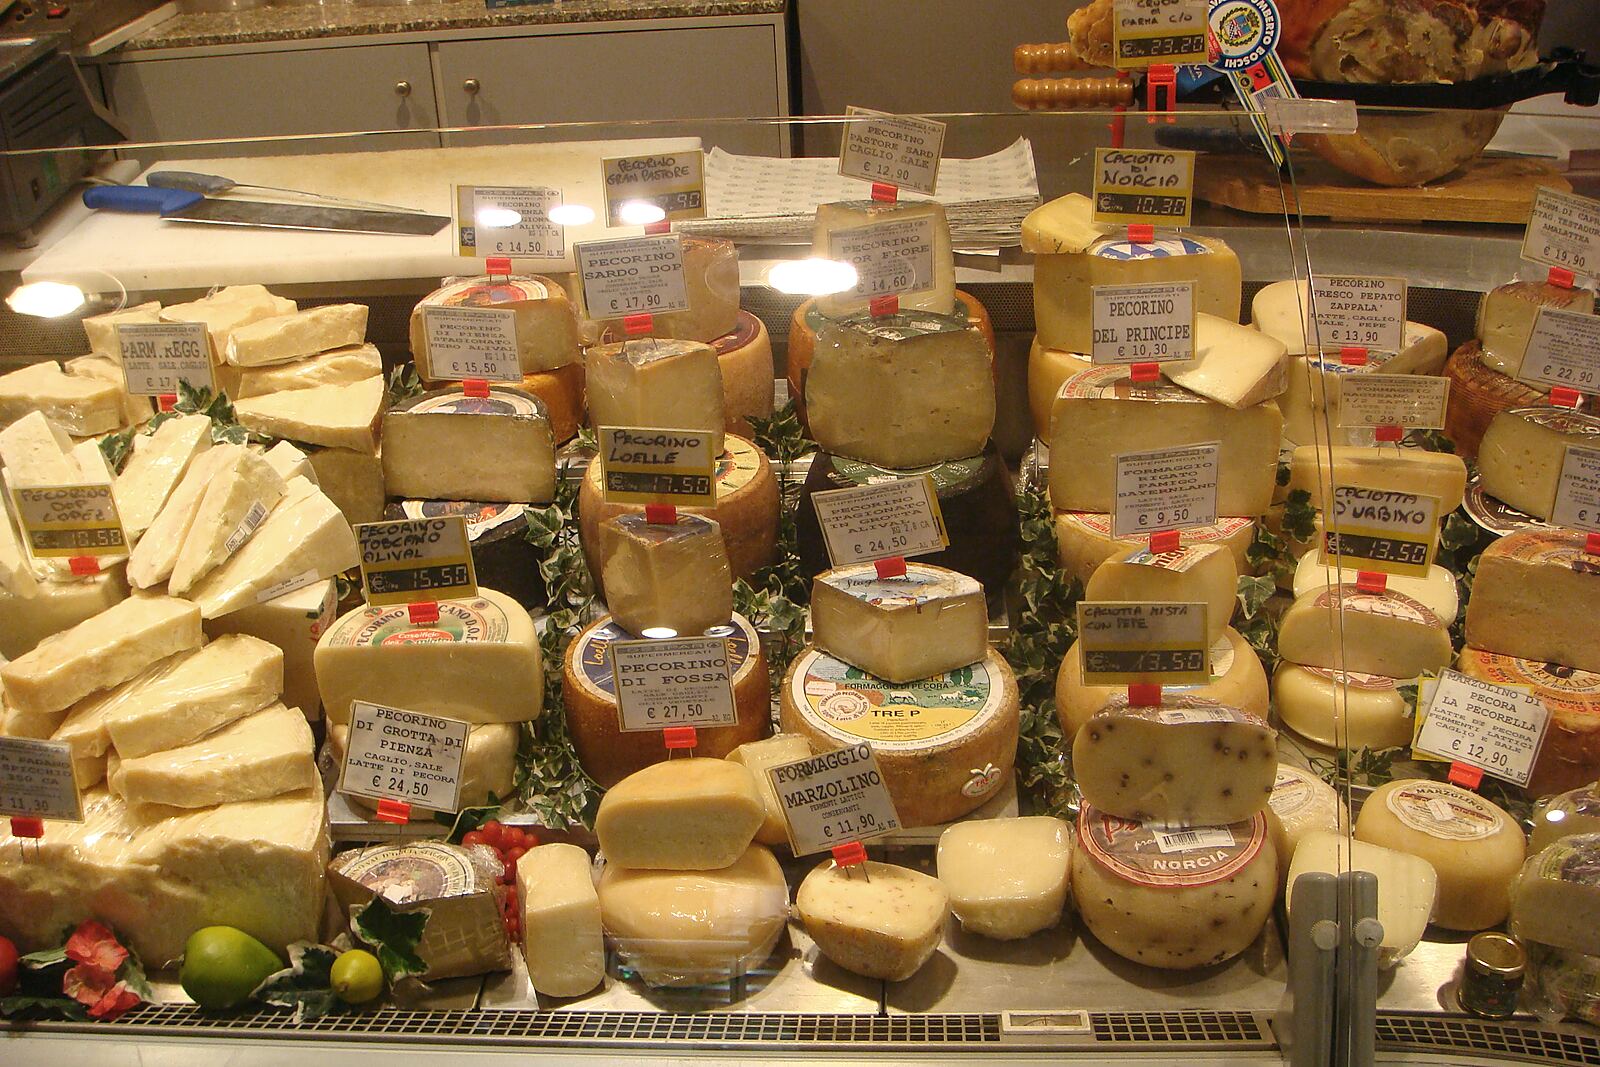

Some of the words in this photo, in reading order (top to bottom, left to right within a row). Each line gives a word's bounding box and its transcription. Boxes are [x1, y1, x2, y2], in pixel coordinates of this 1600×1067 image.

[1122, 17, 1158, 26] PARMA
[1151, 36, 1204, 55] 23.20
[1224, 46, 1265, 68] BOSCHI
[868, 126, 924, 144] PECORINO
[1104, 150, 1175, 164] CACIOTTA
[642, 166, 689, 182] PASTORE
[877, 164, 909, 180] 12,90
[1103, 170, 1179, 186] NORCIA
[1136, 197, 1185, 214] 10.30
[509, 242, 541, 255] 14,50
[842, 235, 920, 254] PECORINO
[882, 245, 929, 259] FIORE
[589, 252, 675, 267] PECORINO
[1555, 249, 1585, 267] 19,90
[585, 268, 638, 280] SARDO
[650, 264, 681, 273] DOP
[872, 275, 907, 291] 14,60
[626, 294, 660, 309] 17,90
[1360, 292, 1401, 301] PEPATO
[1109, 300, 1174, 316] PECORINO
[1094, 328, 1118, 343] DEL
[1126, 324, 1190, 342] PRINCIPE
[1345, 331, 1378, 342] 13,90
[1133, 343, 1168, 357] 10,30
[465, 362, 496, 374] 15,50
[1557, 368, 1593, 382] 22,90
[1380, 416, 1416, 424] 29,50
[609, 448, 679, 464] LOELLE
[1124, 462, 1212, 476] FORMAGGIO
[1138, 471, 1198, 481] RIGATO
[653, 476, 709, 493] 17.50
[824, 501, 926, 523] STAGIONATO
[832, 496, 913, 515] PECORINO
[860, 510, 922, 524] GROTTA
[1139, 514, 1148, 525] €
[1157, 509, 1189, 525] 9,50
[360, 520, 446, 538] PECORINO
[848, 520, 910, 534] ALIVAL
[869, 536, 907, 552] 24,50
[1369, 540, 1426, 562] 13.50
[363, 548, 423, 564] ALIVAL
[413, 566, 467, 588] 15.50
[620, 659, 726, 673] PECORINO
[1136, 652, 1201, 671] 13.50
[621, 678, 646, 687] DI
[662, 673, 729, 684] FOSSA
[1446, 671, 1518, 699] MARZOLINO
[1525, 696, 1540, 706] DI
[1470, 692, 1516, 713] PECORA
[376, 708, 447, 730] PECORINO
[664, 704, 703, 719] 27,50
[1442, 696, 1458, 708] LA
[1466, 704, 1536, 732] PECORELLA
[1429, 712, 1480, 732] FERMENTI
[1487, 731, 1534, 750] LATTICI
[1434, 706, 1466, 720] LATTE
[1492, 725, 1532, 742] PECORA
[356, 720, 374, 731] DI
[383, 725, 436, 743] GROTTA
[445, 737, 462, 748] DI
[1435, 722, 1475, 738] CAGLIO
[1494, 741, 1522, 754] SALE
[380, 739, 433, 757] PIENZA
[1452, 740, 1461, 750] €
[1467, 744, 1508, 766] 12,90
[348, 758, 384, 771] LATTE
[391, 766, 405, 775] DI
[413, 771, 455, 785] PECORA
[775, 744, 870, 784] FORMAGGIO
[372, 775, 381, 787] €
[388, 778, 428, 796] 24,50
[784, 770, 880, 809] MARZOLINO
[824, 825, 832, 838] €
[837, 813, 875, 834] 11,90
[1152, 850, 1230, 870] NORCIA
